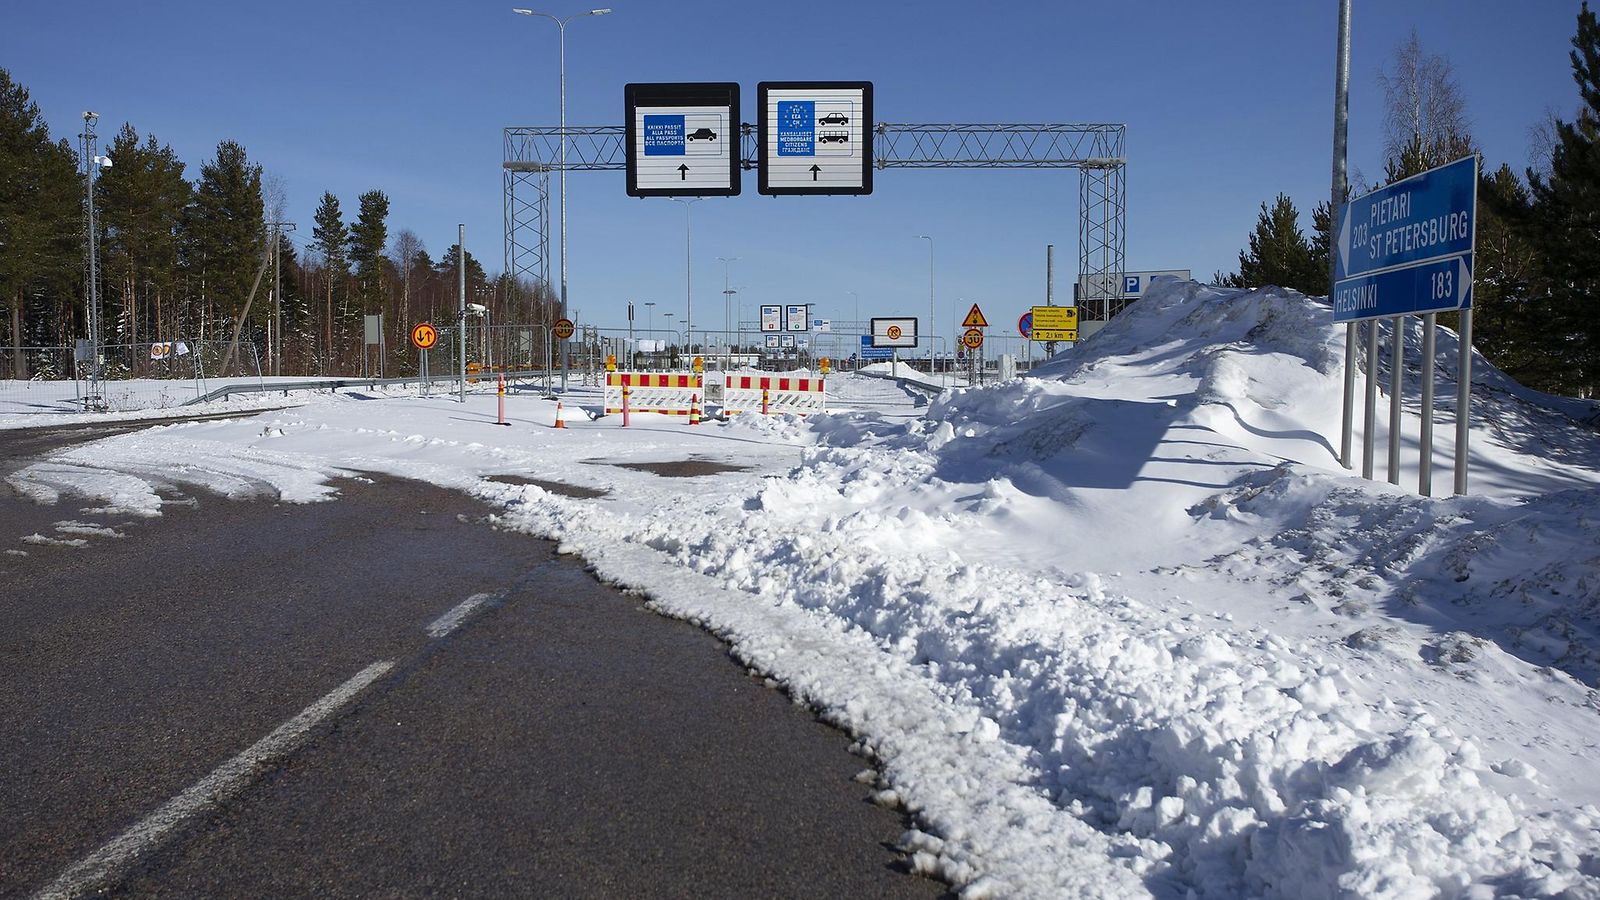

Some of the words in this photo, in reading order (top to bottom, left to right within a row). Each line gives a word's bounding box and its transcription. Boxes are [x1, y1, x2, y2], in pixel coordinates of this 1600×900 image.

[1370, 191, 1411, 228] PIETARI
[1352, 222, 1368, 249] 203
[1369, 233, 1382, 260] ST
[1385, 210, 1468, 256] PETERSBURG
[1126, 278, 1137, 291] P
[1336, 283, 1378, 313] HELSINKI
[1431, 270, 1453, 300] 183
[557, 323, 570, 334] 30
